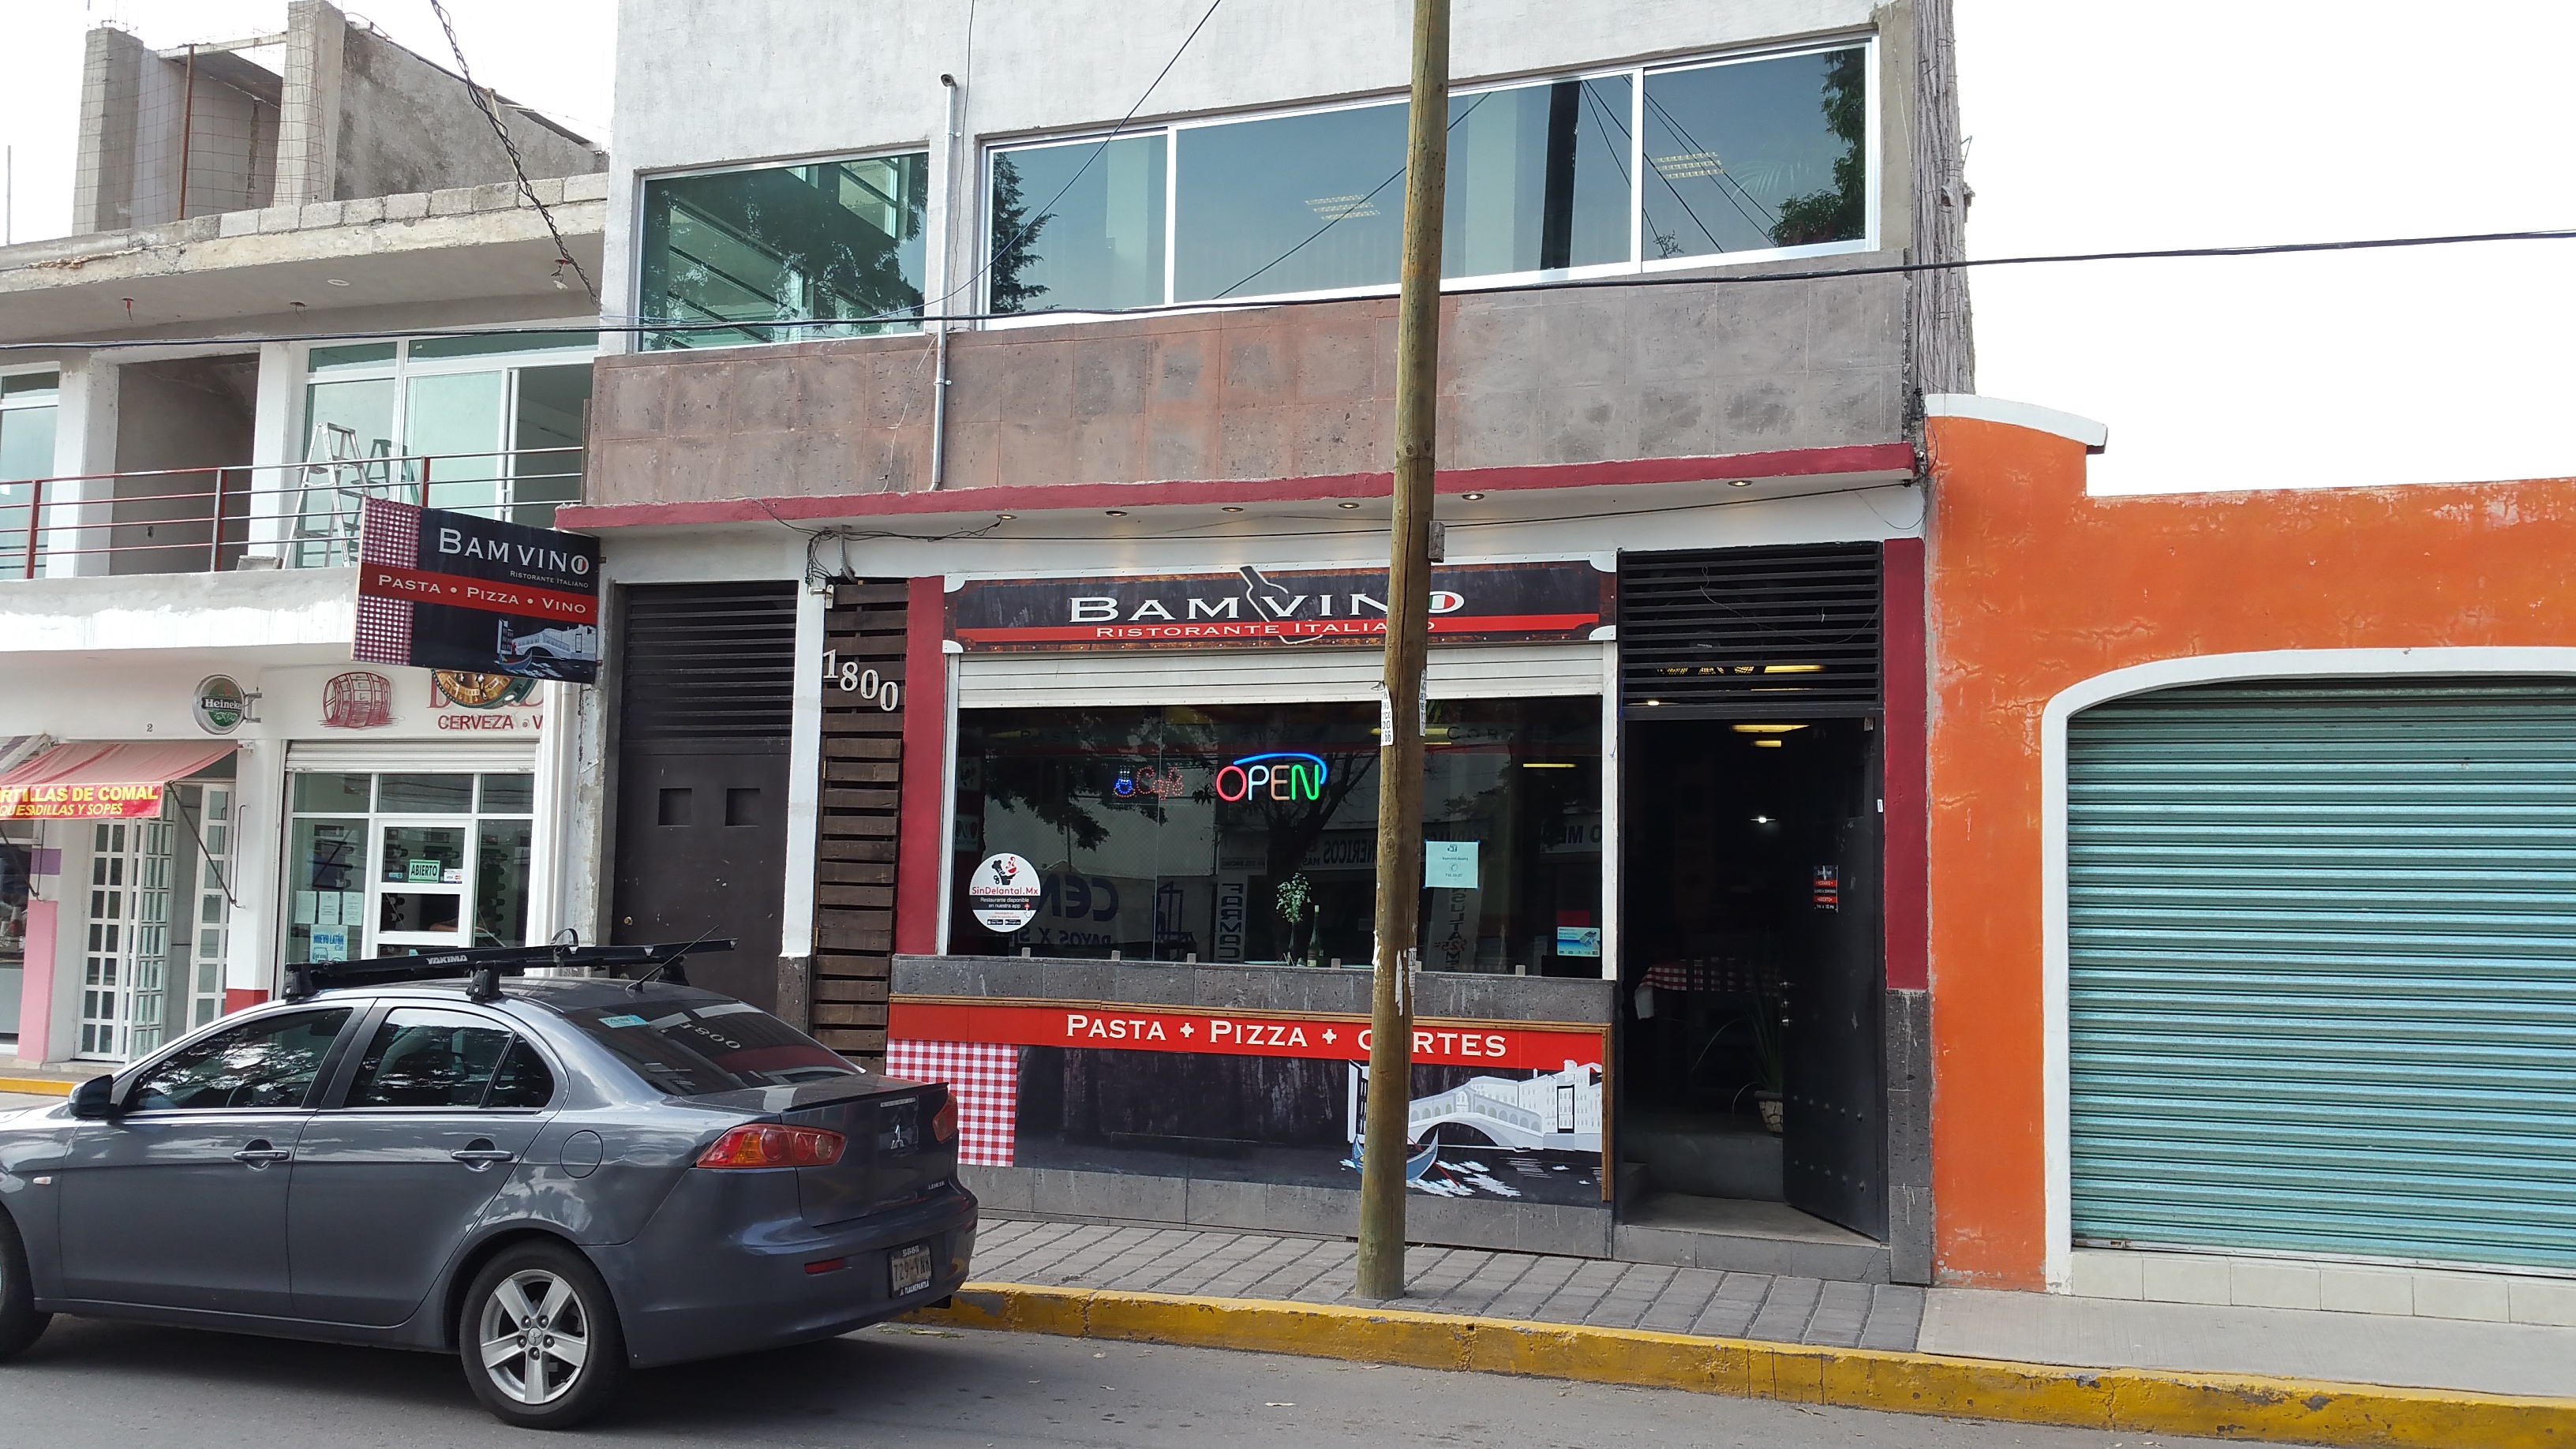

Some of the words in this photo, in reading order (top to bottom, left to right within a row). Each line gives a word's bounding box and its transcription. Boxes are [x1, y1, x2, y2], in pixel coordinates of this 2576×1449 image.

[510, 570, 555, 583] RISTORANTE
[556, 577, 589, 589] ITALIANO
[378, 574, 441, 594] PASTA
[466, 586, 519, 605] PIZZA
[541, 597, 586, 614] VINO
[1096, 625, 1279, 638] RISTORANTE
[1295, 623, 1436, 634] ITALIA
[822, 649, 899, 712] 1800
[204, 698, 242, 710] Heineke
[147, 723, 153, 732] 2
[438, 714, 514, 730] CERVEZA
[1215, 764, 1320, 802] OPEN
[72, 787, 94, 802] DE
[98, 785, 159, 801] COMAL
[78, 803, 87, 815] Y
[87, 803, 123, 815] SOPES
[410, 864, 438, 877] ABIERTO
[972, 886, 1039, 895] SinDelantal.Mx
[426, 954, 468, 965] YAKIMA
[1066, 1014, 1166, 1041] PASTA
[1209, 1020, 1308, 1048] PIZZA
